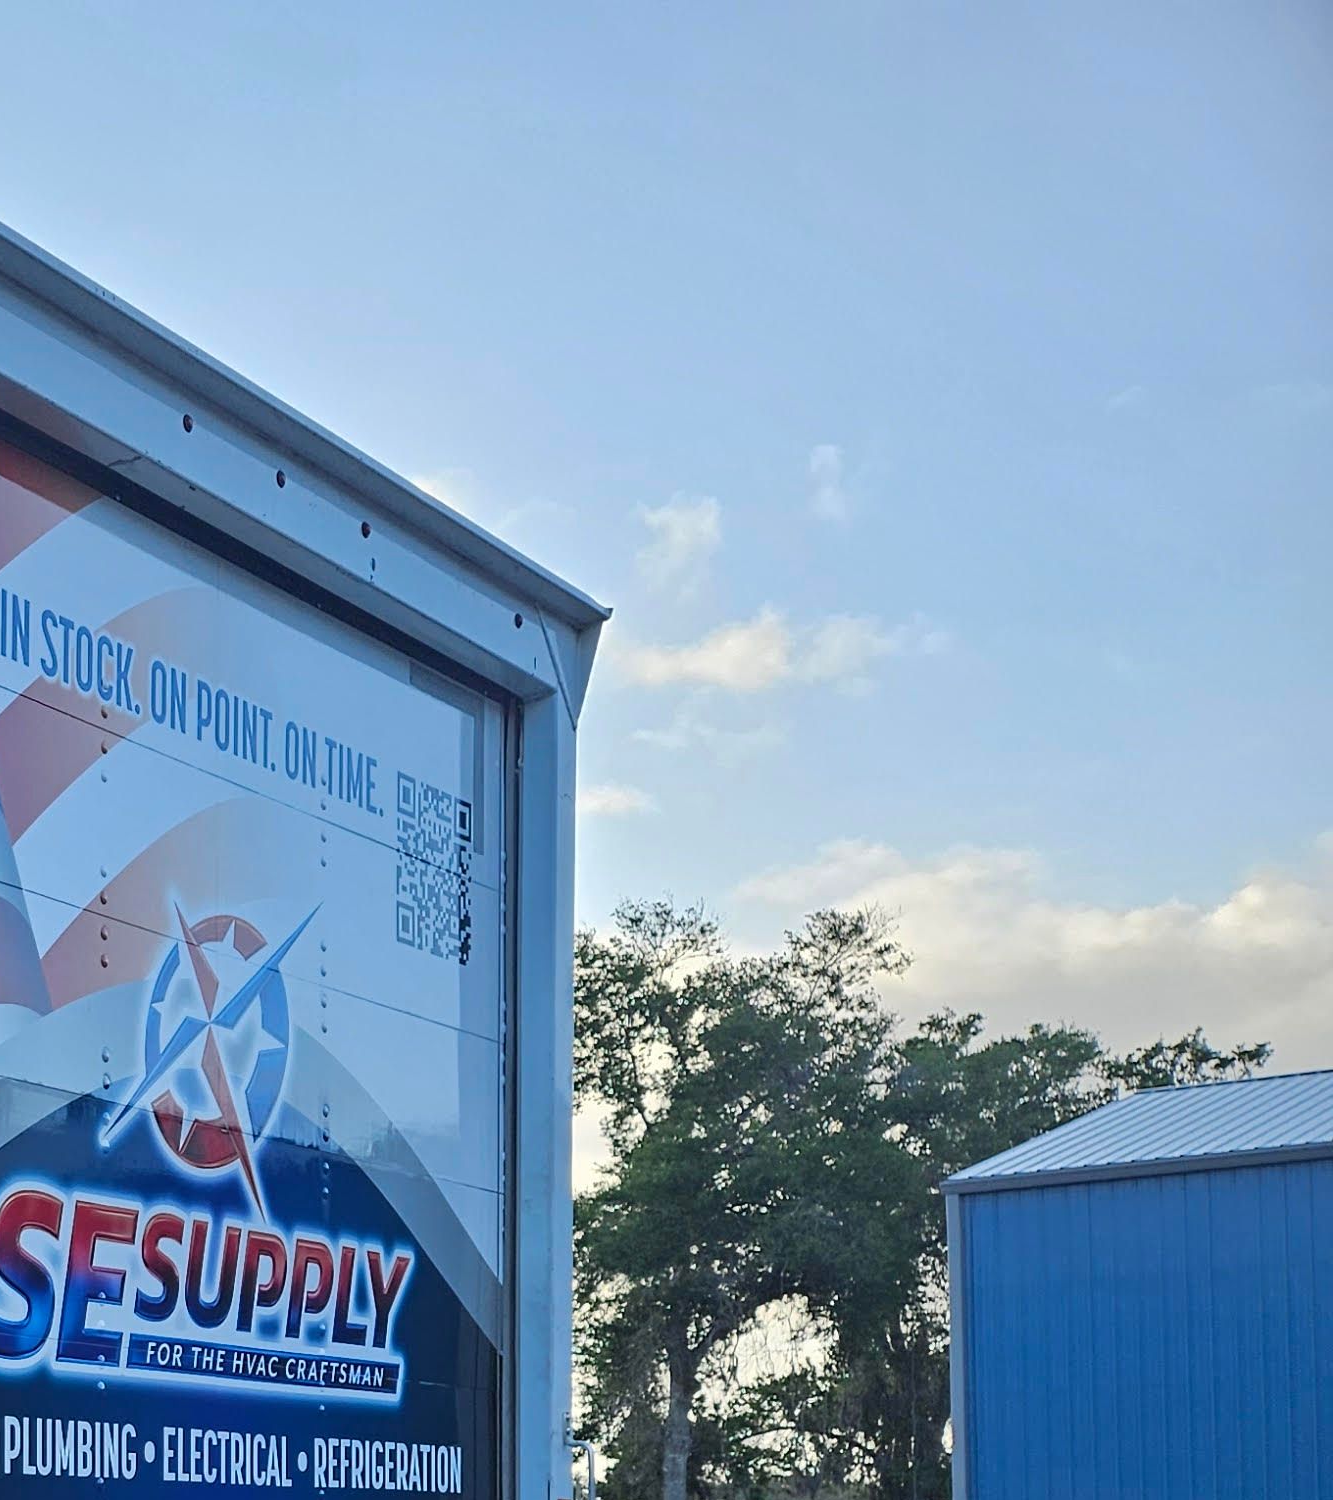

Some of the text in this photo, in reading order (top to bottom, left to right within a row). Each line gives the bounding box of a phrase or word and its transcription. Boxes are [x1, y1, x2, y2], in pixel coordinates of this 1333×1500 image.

[0, 588, 384, 818] IN STOCK. ON POINT. ON TIME.
[145, 1341, 385, 1387] FOR THE HVAC CRAFTSMAN
[3, 1415, 136, 1480] PLUMBING
[162, 1426, 292, 1489] ELECTRICAL
[313, 1437, 462, 1495] REFRIGERATION
